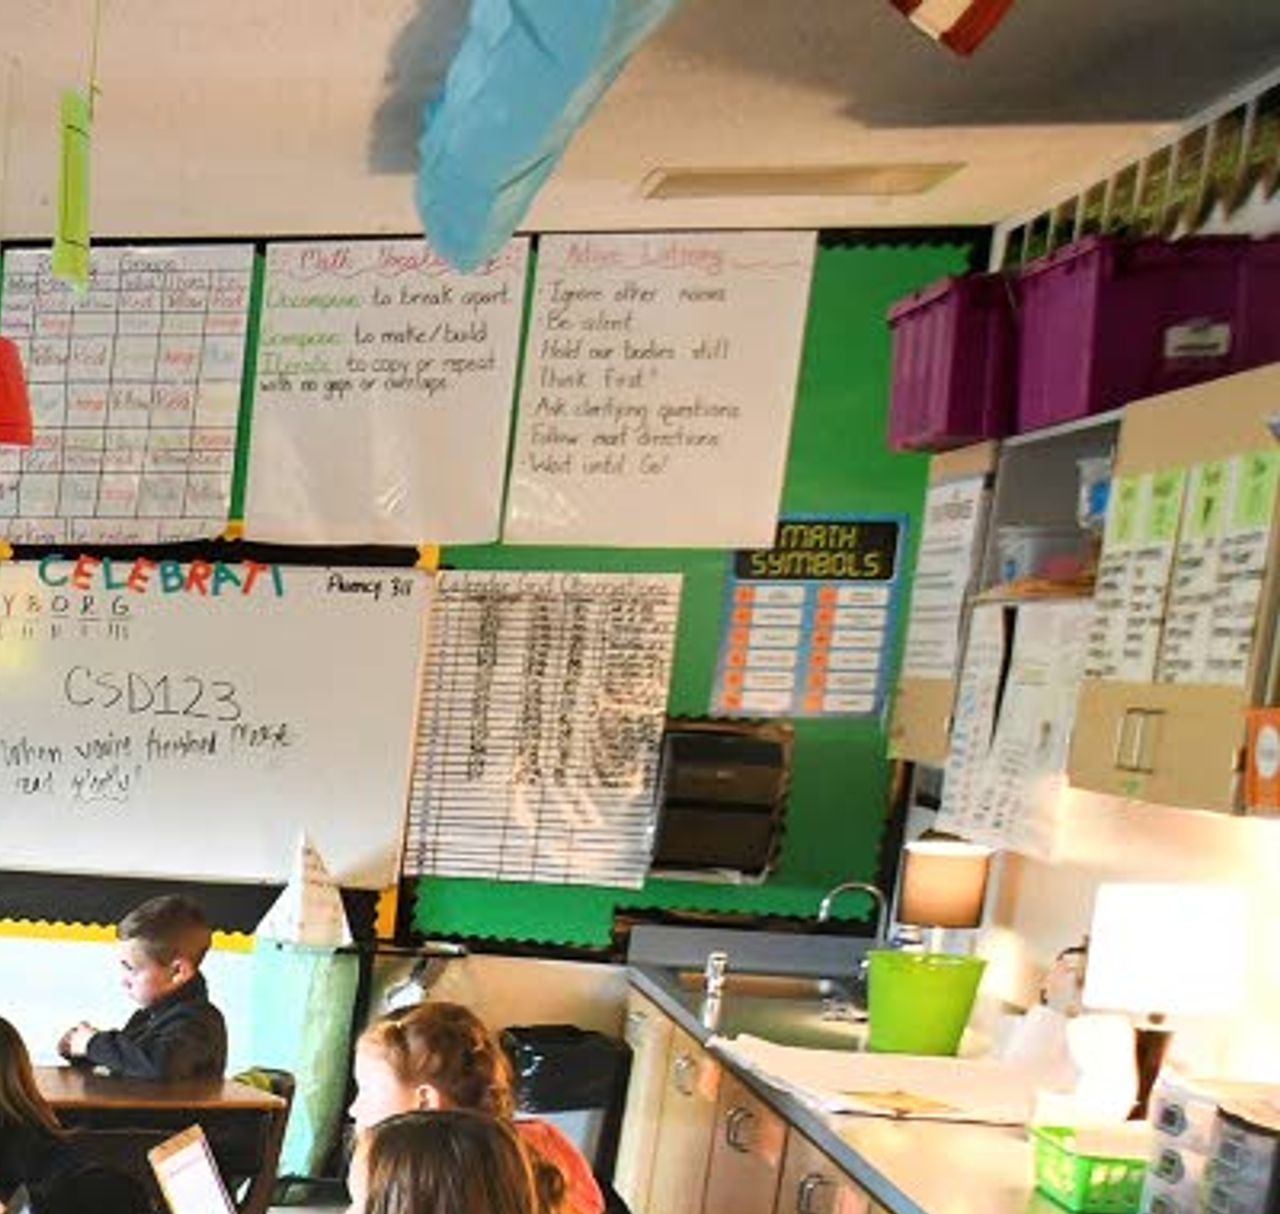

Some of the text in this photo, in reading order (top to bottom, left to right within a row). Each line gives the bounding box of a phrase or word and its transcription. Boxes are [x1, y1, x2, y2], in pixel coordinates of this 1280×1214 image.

[373, 286, 392, 307] to
[400, 283, 453, 305] break
[460, 285, 510, 313] apart
[355, 324, 375, 345] to
[546, 311, 634, 332] Be silent
[541, 339, 582, 360] Hold
[690, 334, 729, 360] still
[442, 355, 496, 376] repeat
[541, 366, 588, 389] Think
[781, 524, 859, 548] MATH
[750, 551, 882, 578] SYMBOLS
[326, 571, 383, 601] Fluency
[64, 665, 241, 722] CSD123
[0, 735, 62, 767] When
